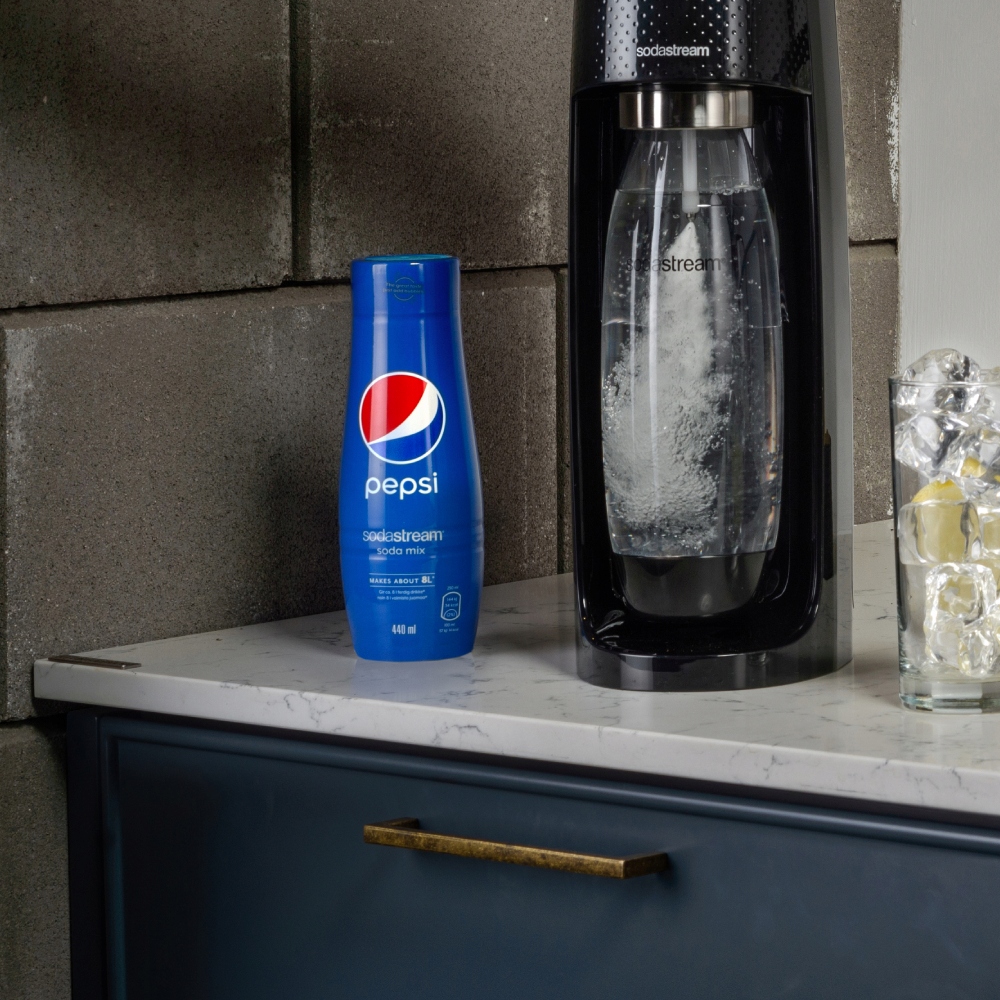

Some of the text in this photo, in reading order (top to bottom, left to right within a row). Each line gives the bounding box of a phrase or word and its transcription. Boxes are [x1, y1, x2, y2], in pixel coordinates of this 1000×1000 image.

[636, 43, 710, 57] sodastream
[365, 471, 438, 500] pepsi
[362, 528, 443, 543] sodastream
[376, 546, 426, 555] soda mix
[392, 624, 417, 635] 440 ml
